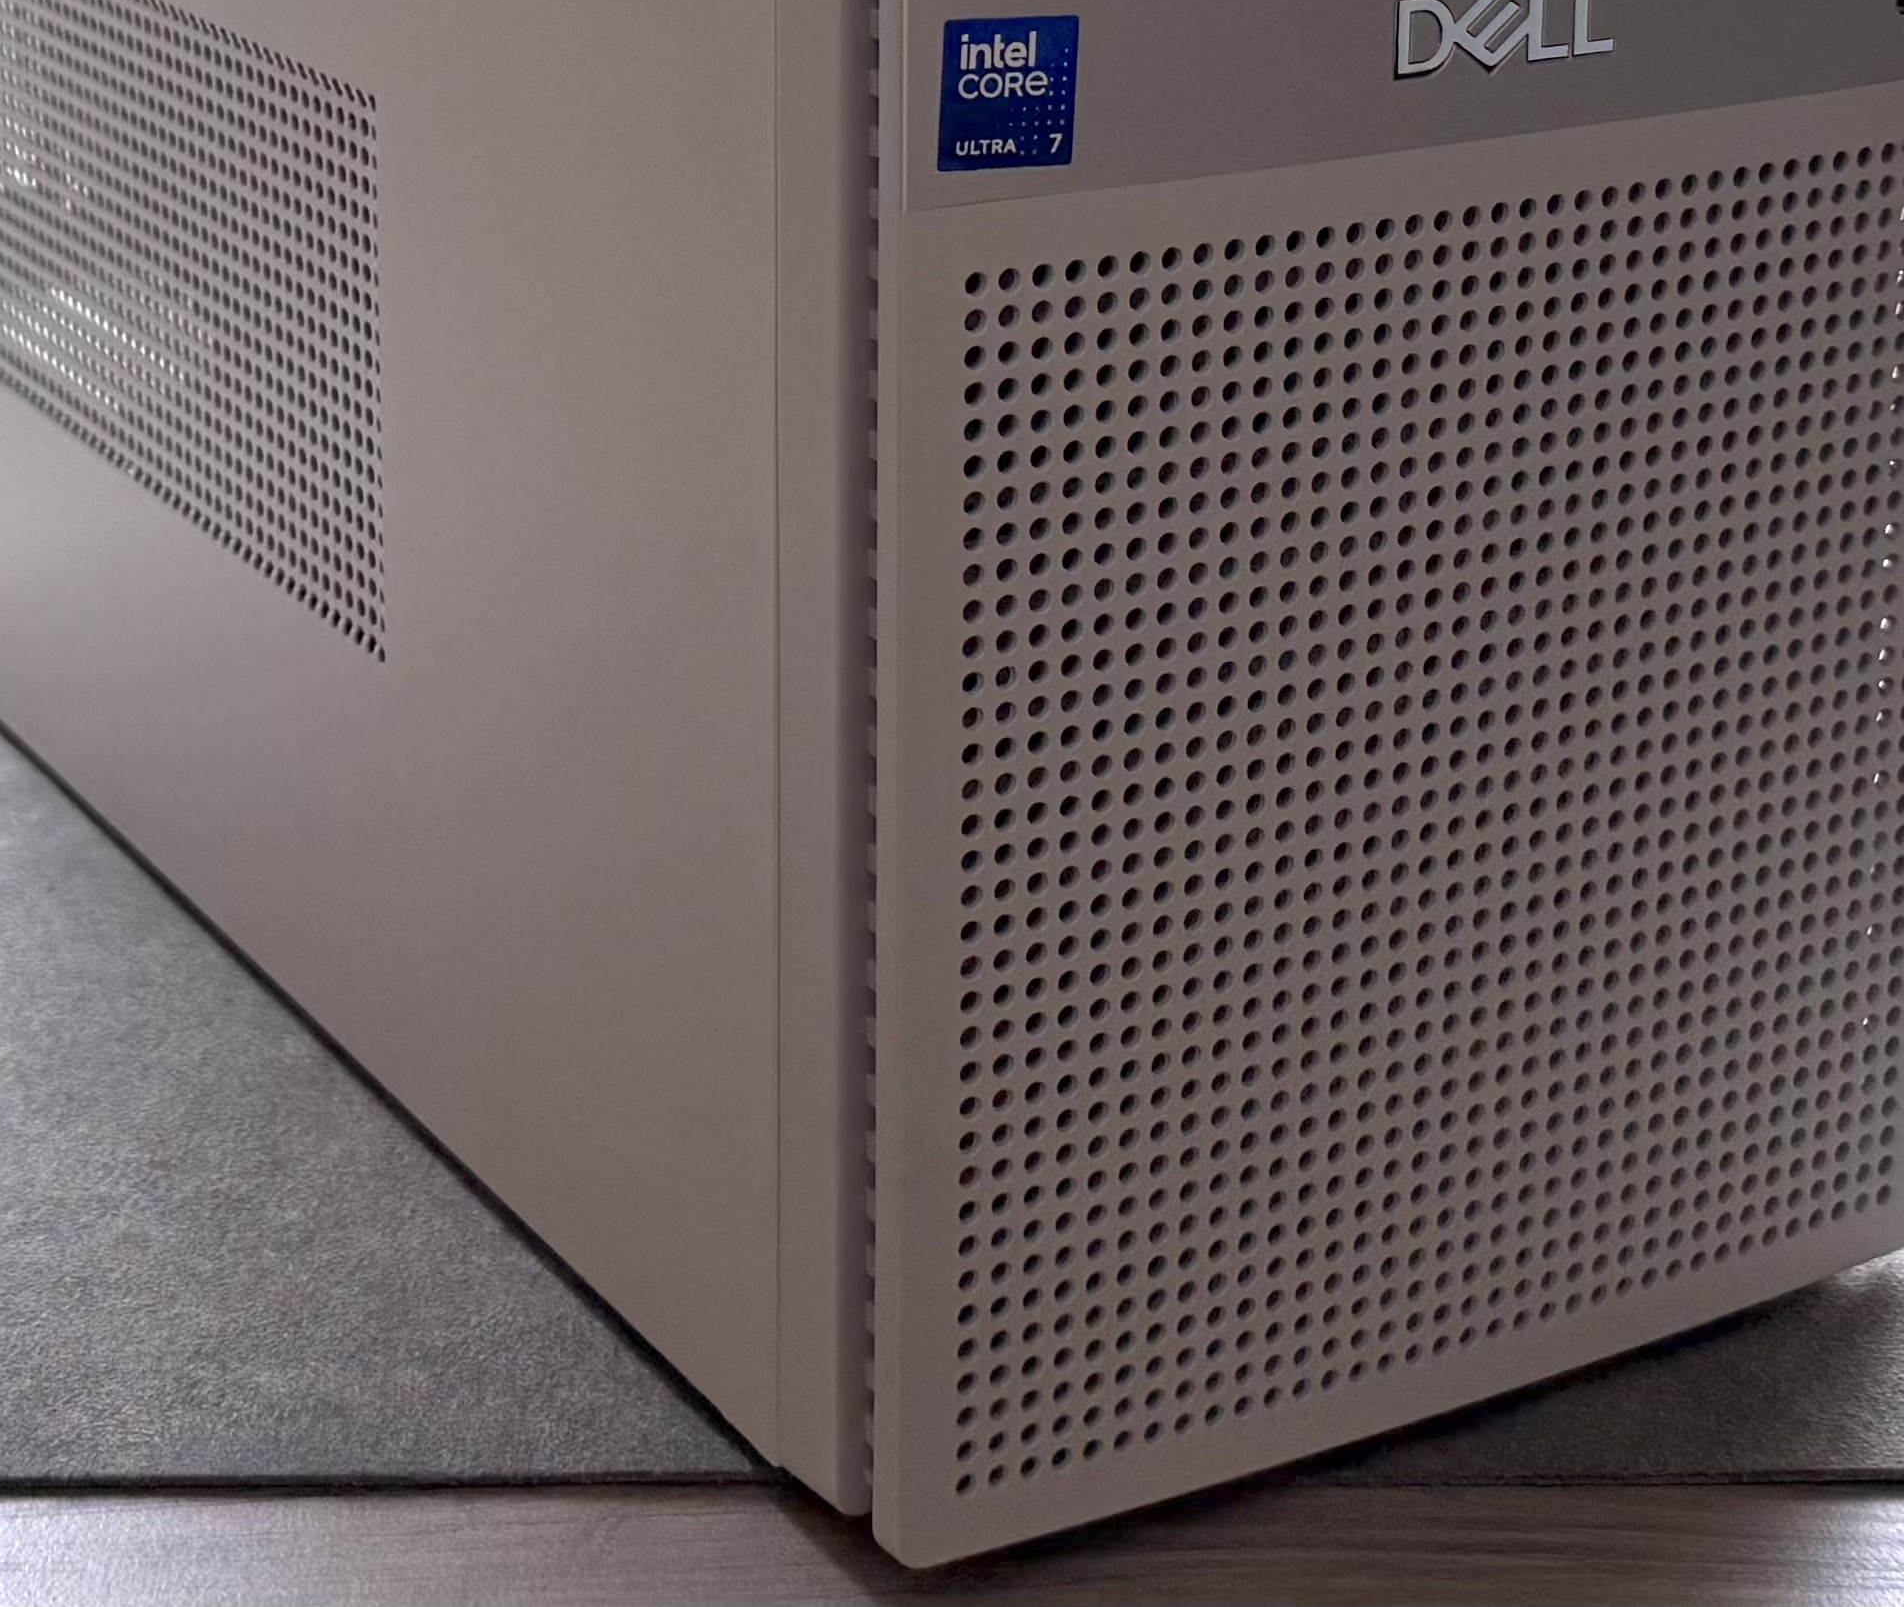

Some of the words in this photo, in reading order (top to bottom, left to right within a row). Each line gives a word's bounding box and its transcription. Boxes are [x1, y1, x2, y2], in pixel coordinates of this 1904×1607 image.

[960, 31, 1037, 70] intel
[955, 138, 1017, 156] ULTRA
[1049, 133, 1063, 154] 7
